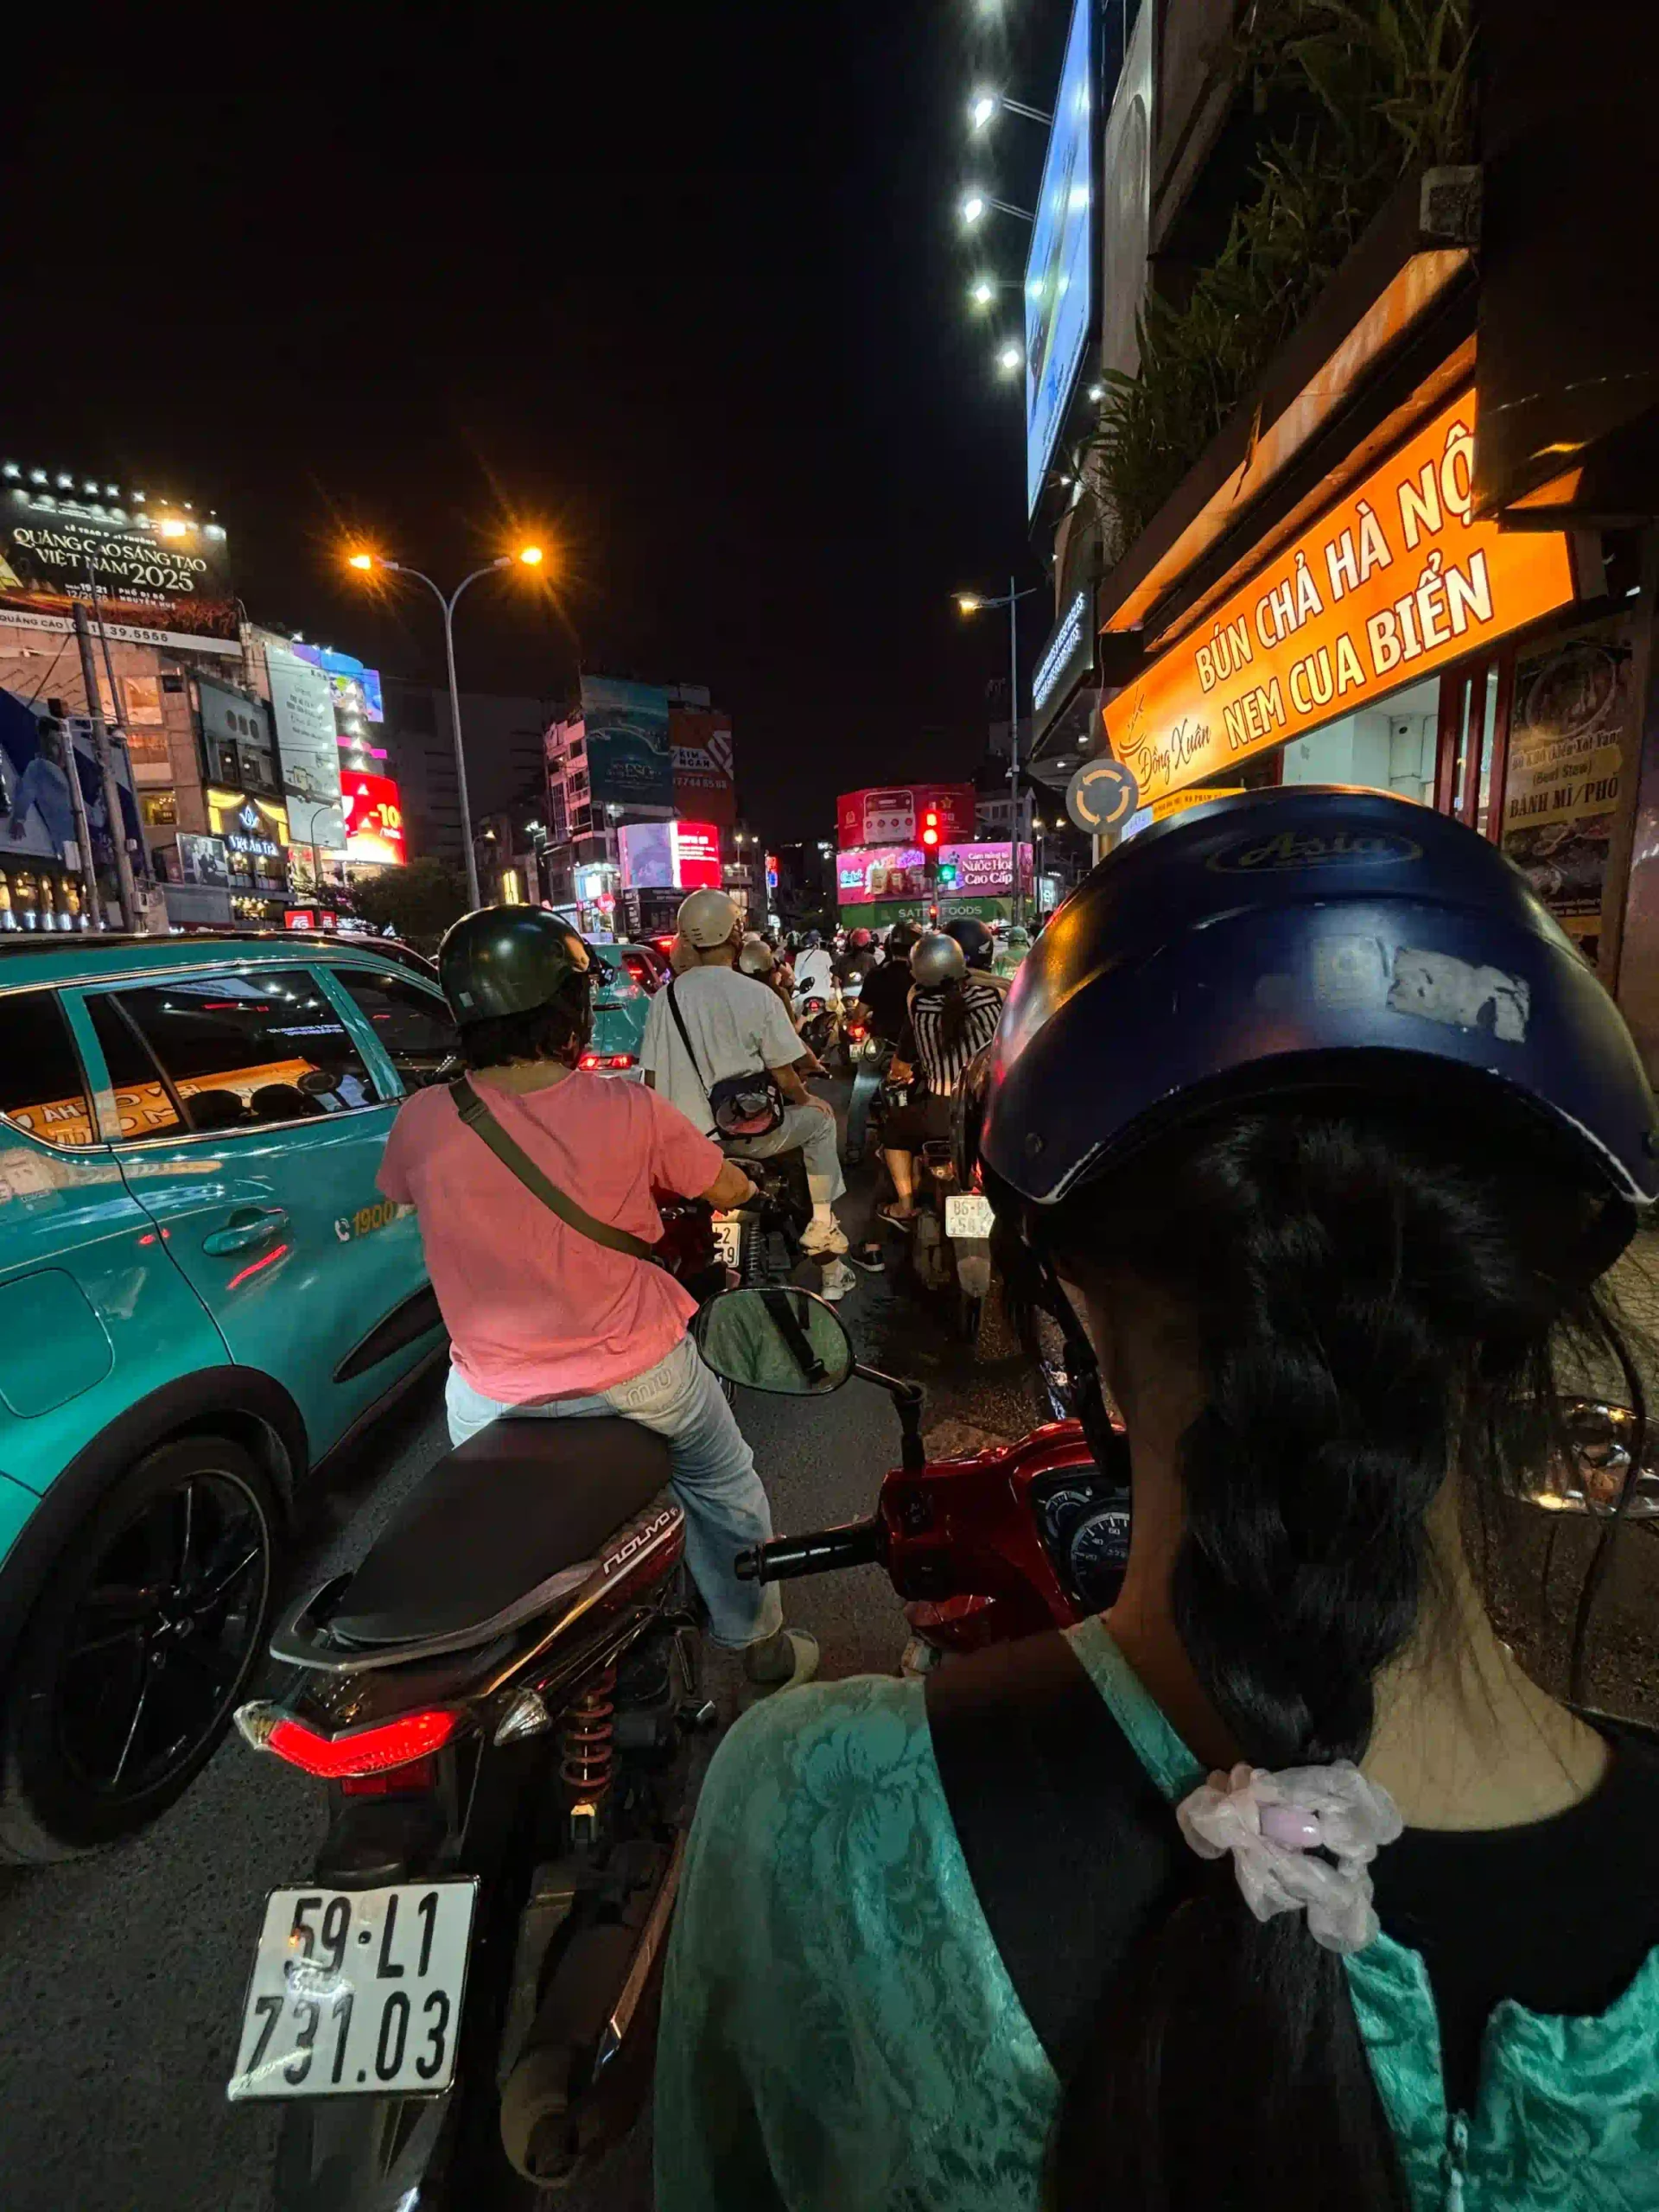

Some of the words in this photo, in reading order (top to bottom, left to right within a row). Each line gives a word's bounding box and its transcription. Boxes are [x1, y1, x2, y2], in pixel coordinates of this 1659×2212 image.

[13, 527, 82, 551] QUẢNG
[123, 545, 171, 565] SÁNG
[171, 554, 207, 573] TẠO
[35, 548, 81, 567] VIỆT
[84, 556, 129, 575] NAM
[130, 563, 195, 592] 2025
[1194, 613, 1254, 693] BÚN
[1255, 555, 1324, 650] CHẢ
[1324, 499, 1395, 601] HÀ
[1397, 419, 1474, 550] NỘ
[1222, 685, 1286, 751] NEM
[1289, 634, 1366, 715] CUA
[1367, 549, 1495, 677] BIỂN
[1138, 745, 1171, 788] Đồng
[1172, 717, 1211, 770] Xuân
[964, 873, 988, 885] Cao
[244, 1989, 451, 2085] 731.03
